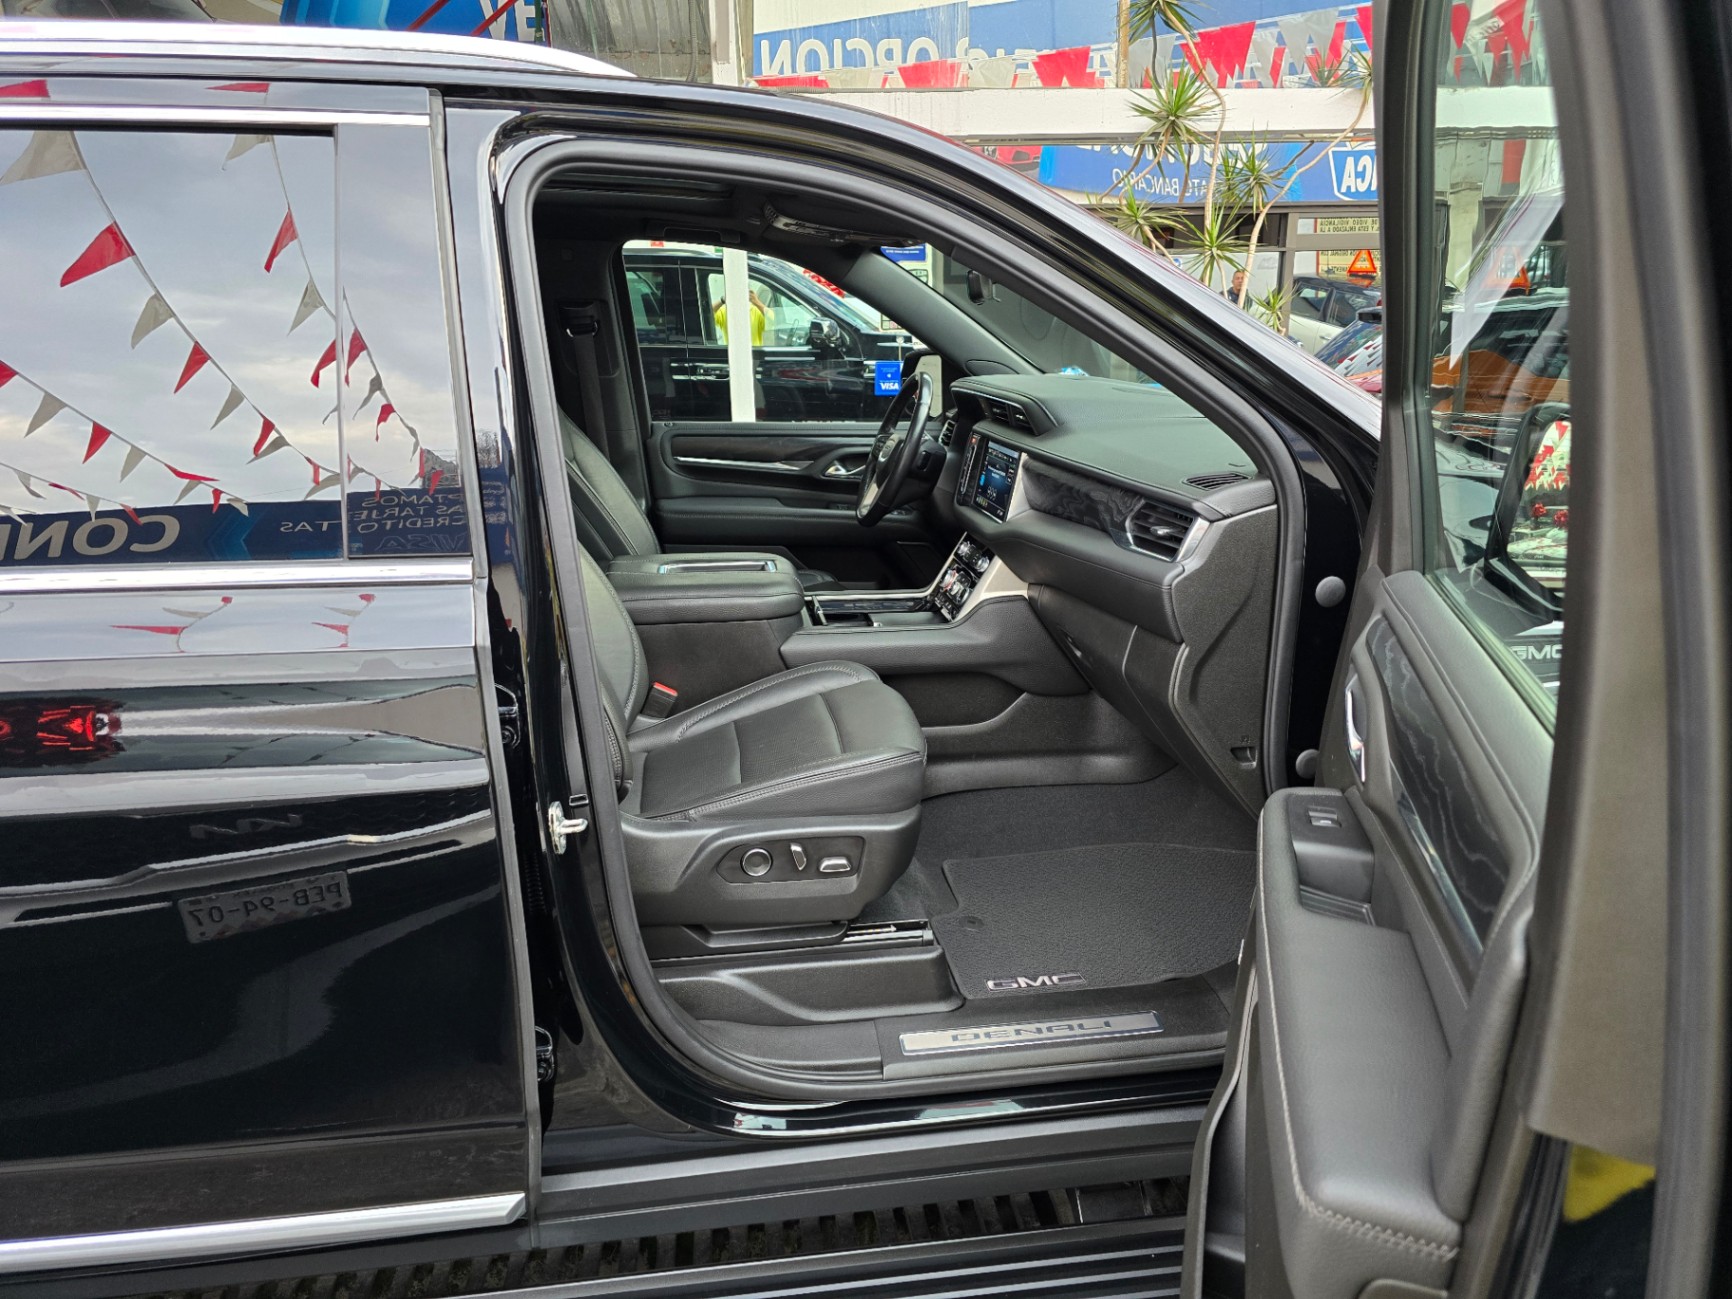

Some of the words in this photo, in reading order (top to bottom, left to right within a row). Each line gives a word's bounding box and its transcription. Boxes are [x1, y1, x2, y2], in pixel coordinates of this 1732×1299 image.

[879, 382, 899, 390] VISA
[986, 972, 1086, 992] GMC
[950, 1020, 1112, 1042] DENALI
